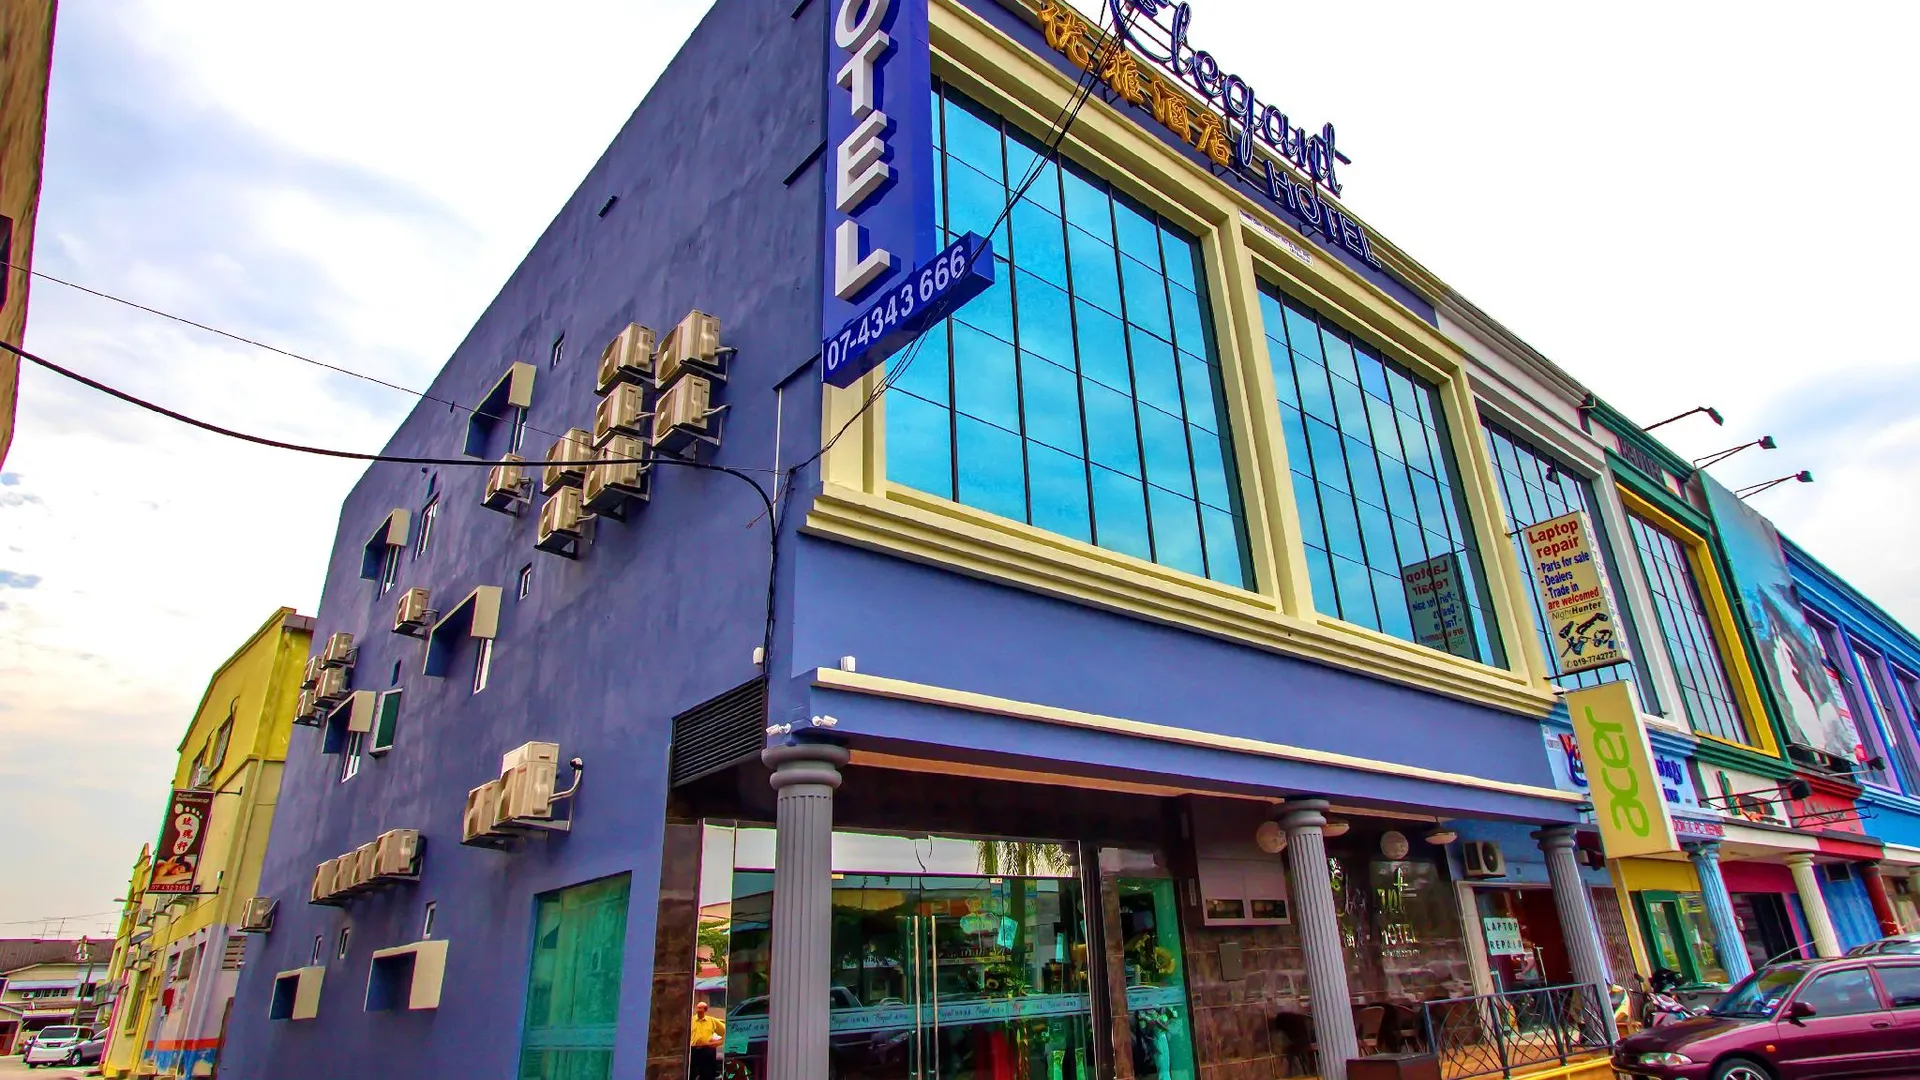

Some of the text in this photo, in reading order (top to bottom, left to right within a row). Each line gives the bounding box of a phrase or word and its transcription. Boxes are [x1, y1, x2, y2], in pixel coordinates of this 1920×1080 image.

[1264, 160, 1382, 272] HOTEL
[827, 245, 965, 371] 07-4343 666
[1527, 520, 1579, 545] Laptop
[1536, 535, 1579, 558] repair
[1562, 555, 1572, 566] for
[1574, 551, 1590, 563] sale
[1548, 586, 1600, 610] are welcomed
[1570, 582, 1579, 593] in
[1573, 650, 1618, 667] 019-7742727
[1584, 705, 1650, 838] acer
[1486, 921, 1518, 931] LAPTOP
[1489, 939, 1522, 950] REPAIR
